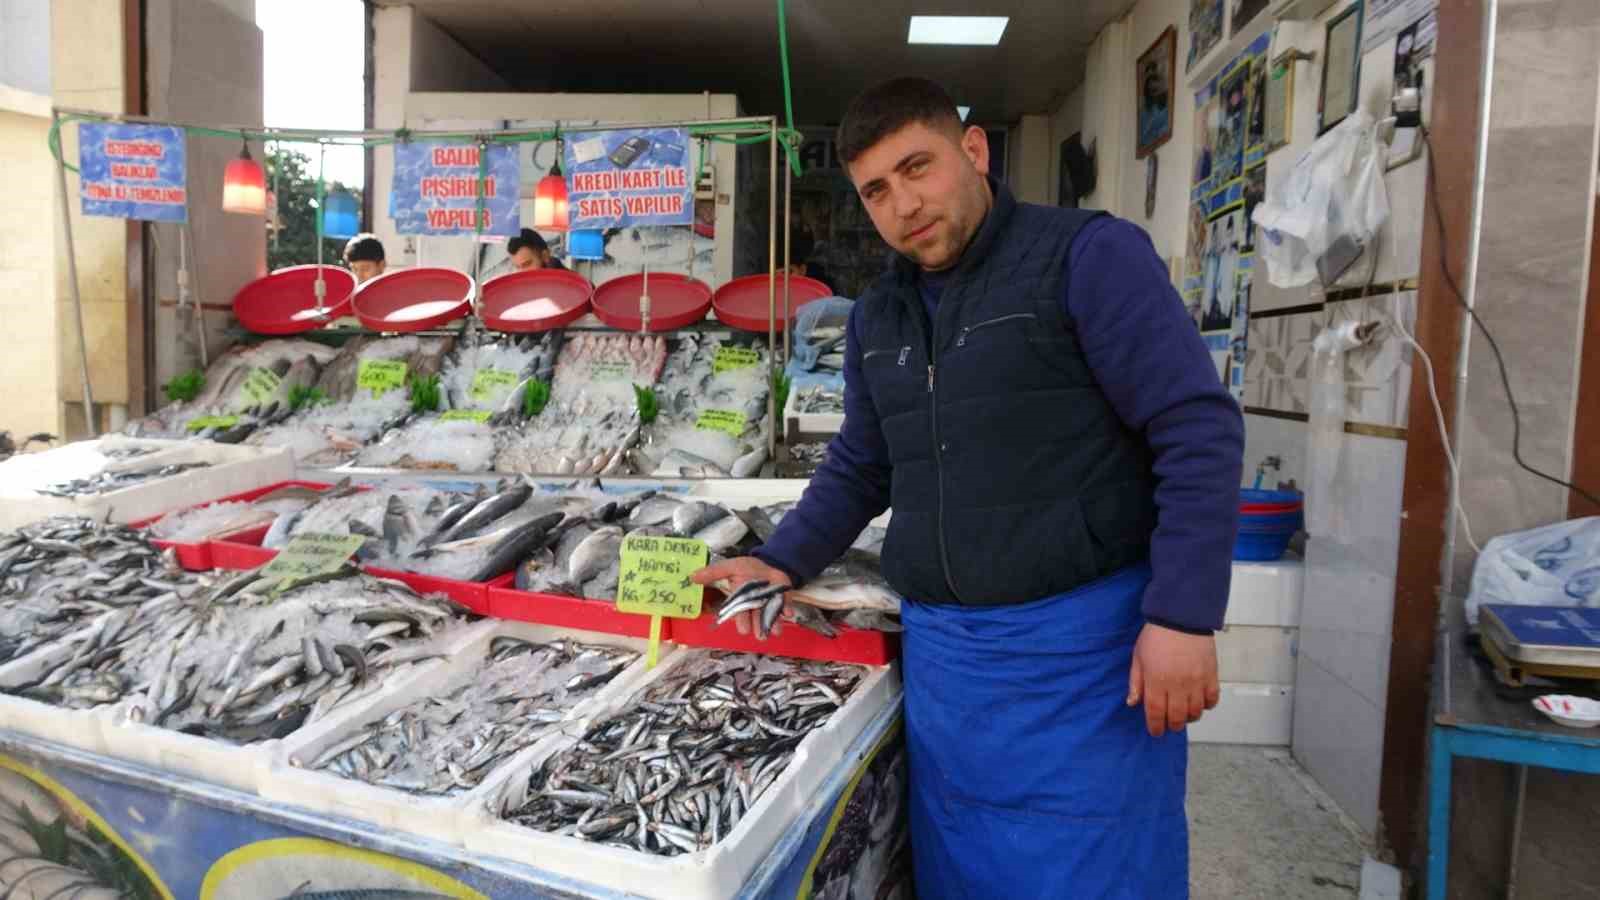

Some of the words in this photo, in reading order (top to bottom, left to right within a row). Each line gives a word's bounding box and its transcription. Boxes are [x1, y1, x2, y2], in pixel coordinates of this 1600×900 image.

[574, 170, 617, 190] KREDİ
[623, 169, 661, 188] KART
[665, 165, 685, 186] İLE
[427, 210, 490, 227] YAPILR
[579, 198, 622, 219] SATIŞ
[626, 194, 683, 214] YAPILIR
